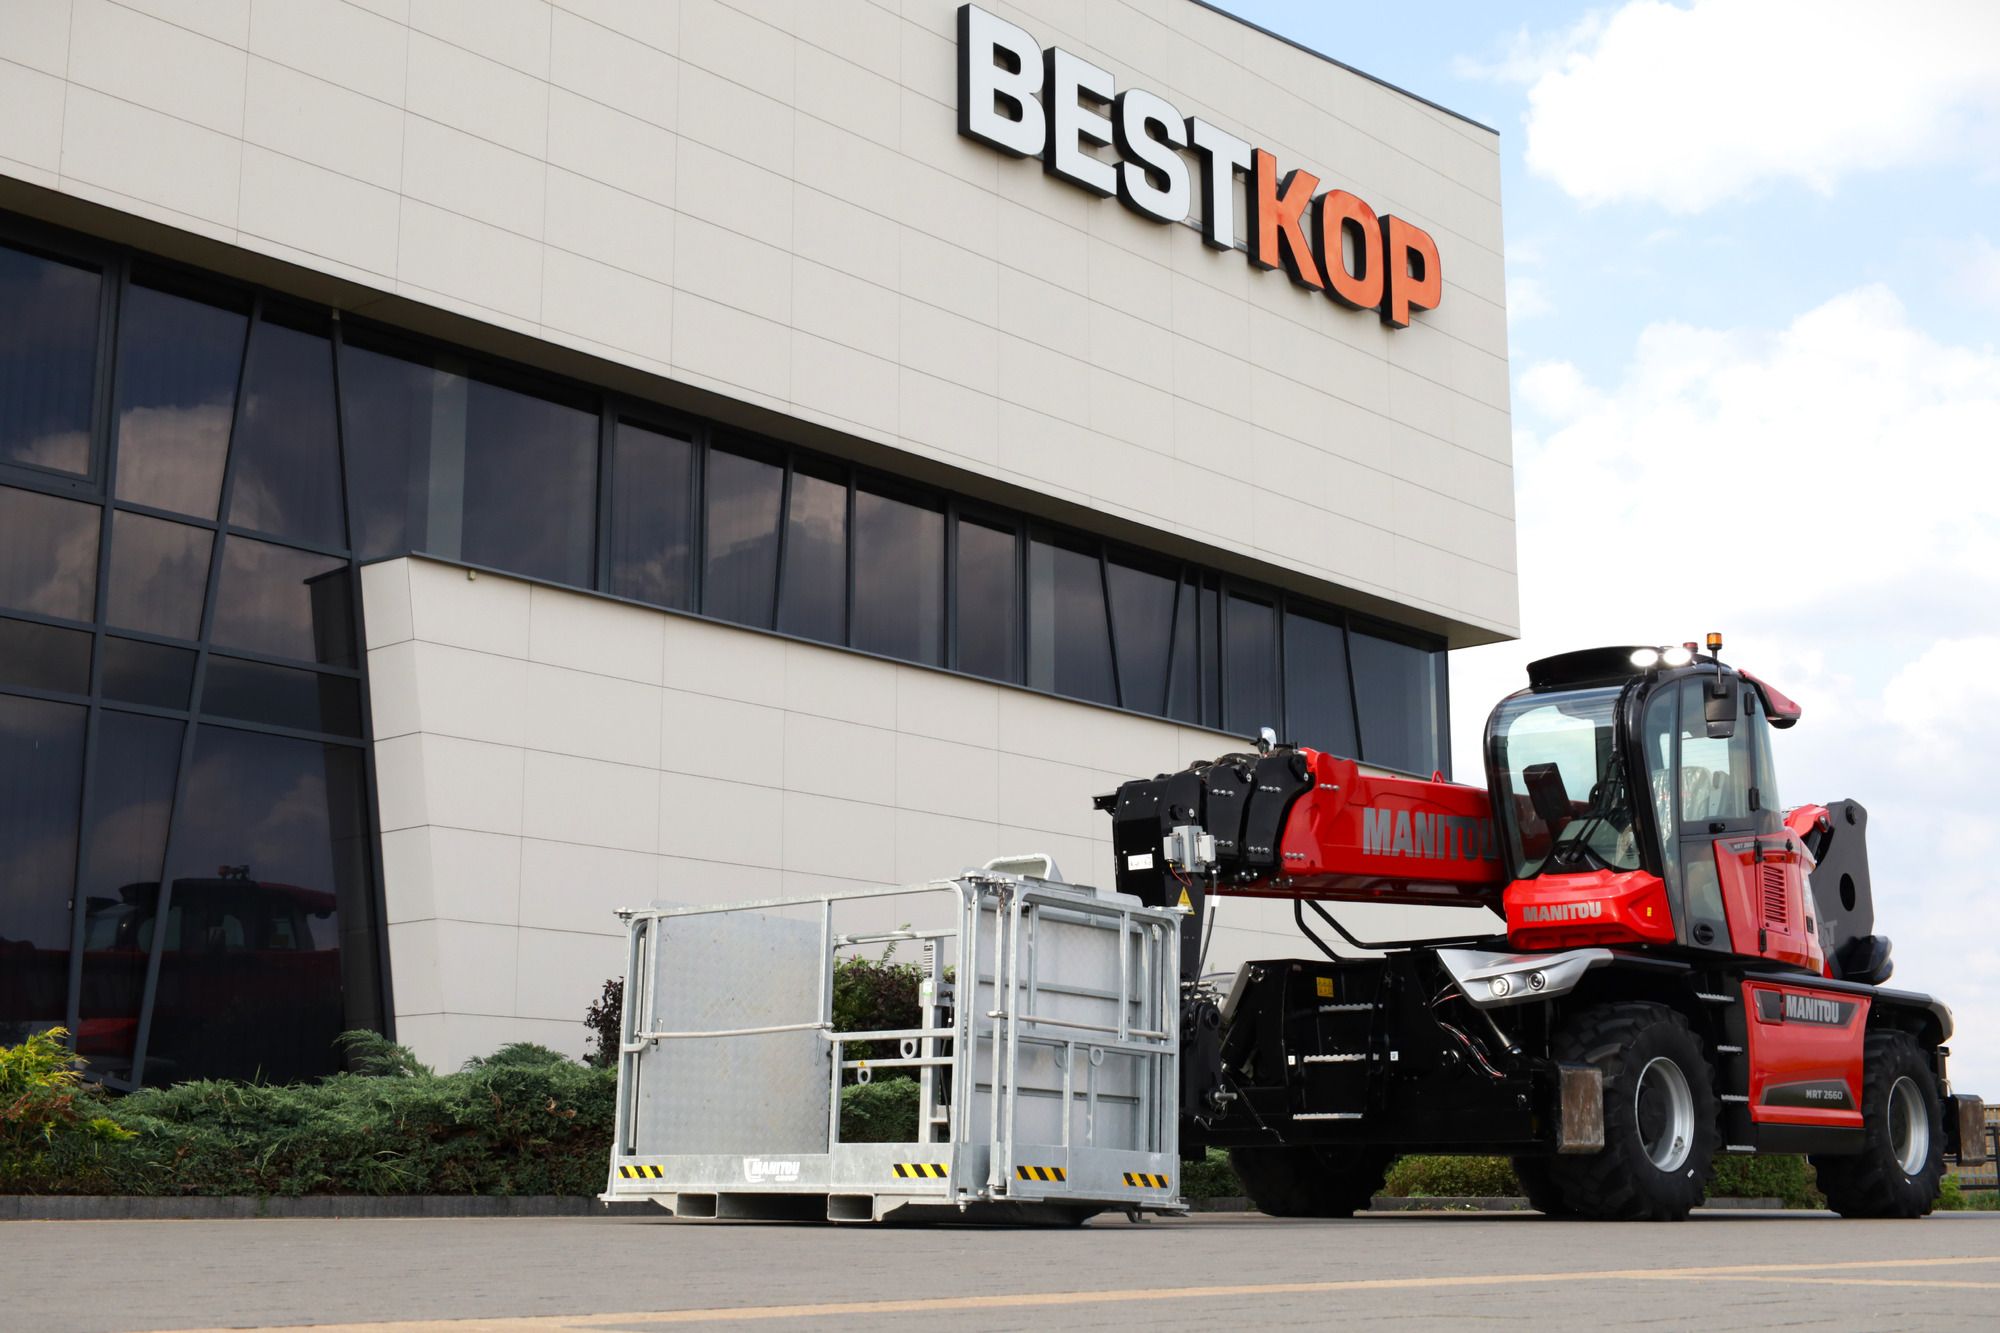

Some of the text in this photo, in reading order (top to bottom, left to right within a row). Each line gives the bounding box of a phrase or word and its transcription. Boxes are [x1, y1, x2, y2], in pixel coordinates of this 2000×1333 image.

[957, 3, 1442, 329] BESTKOP
[1523, 901, 1602, 922] MANITOU
[1786, 994, 1840, 1024] MANITOU
[1806, 1089, 1823, 1100] MRT
[751, 1161, 800, 1175] MANITOU
